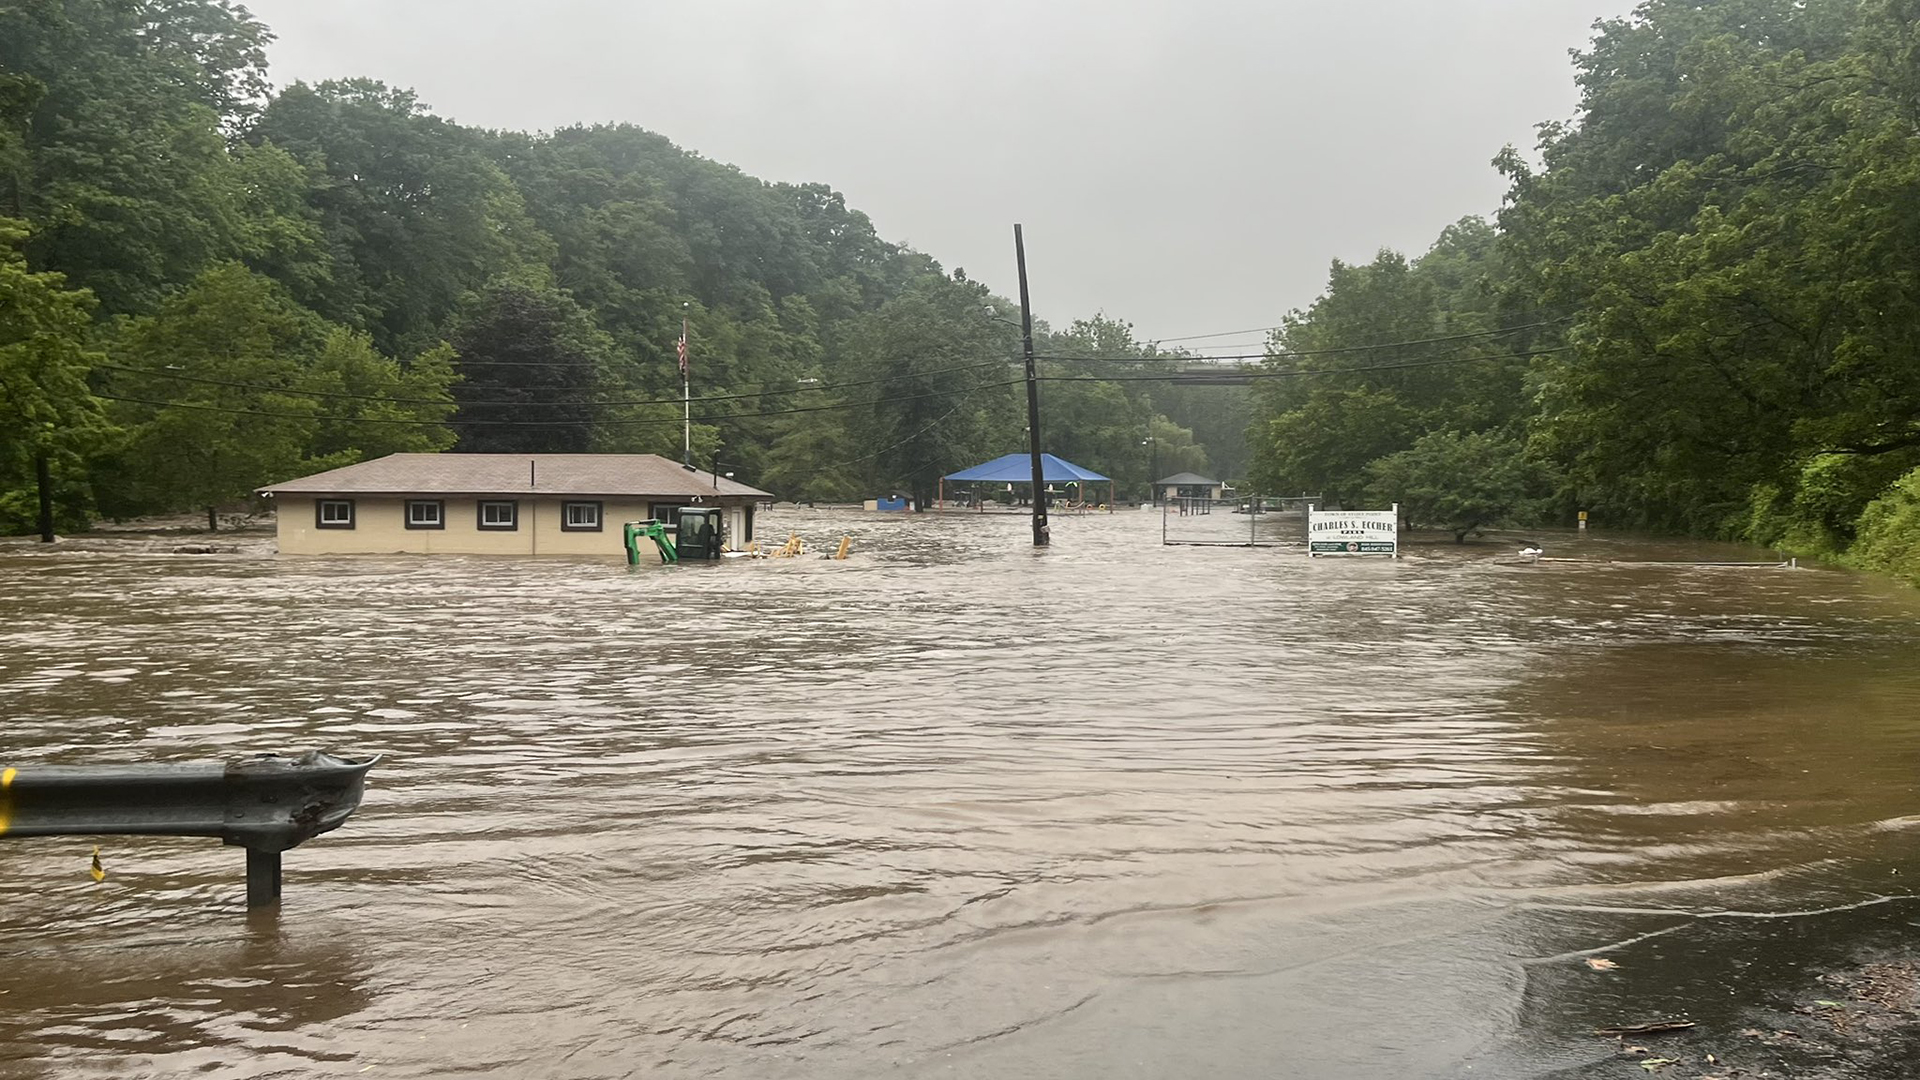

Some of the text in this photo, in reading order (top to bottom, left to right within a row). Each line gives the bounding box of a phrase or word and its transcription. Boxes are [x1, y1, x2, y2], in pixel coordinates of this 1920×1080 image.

[1312, 520, 1393, 532] CHARLES S. ECCHER
